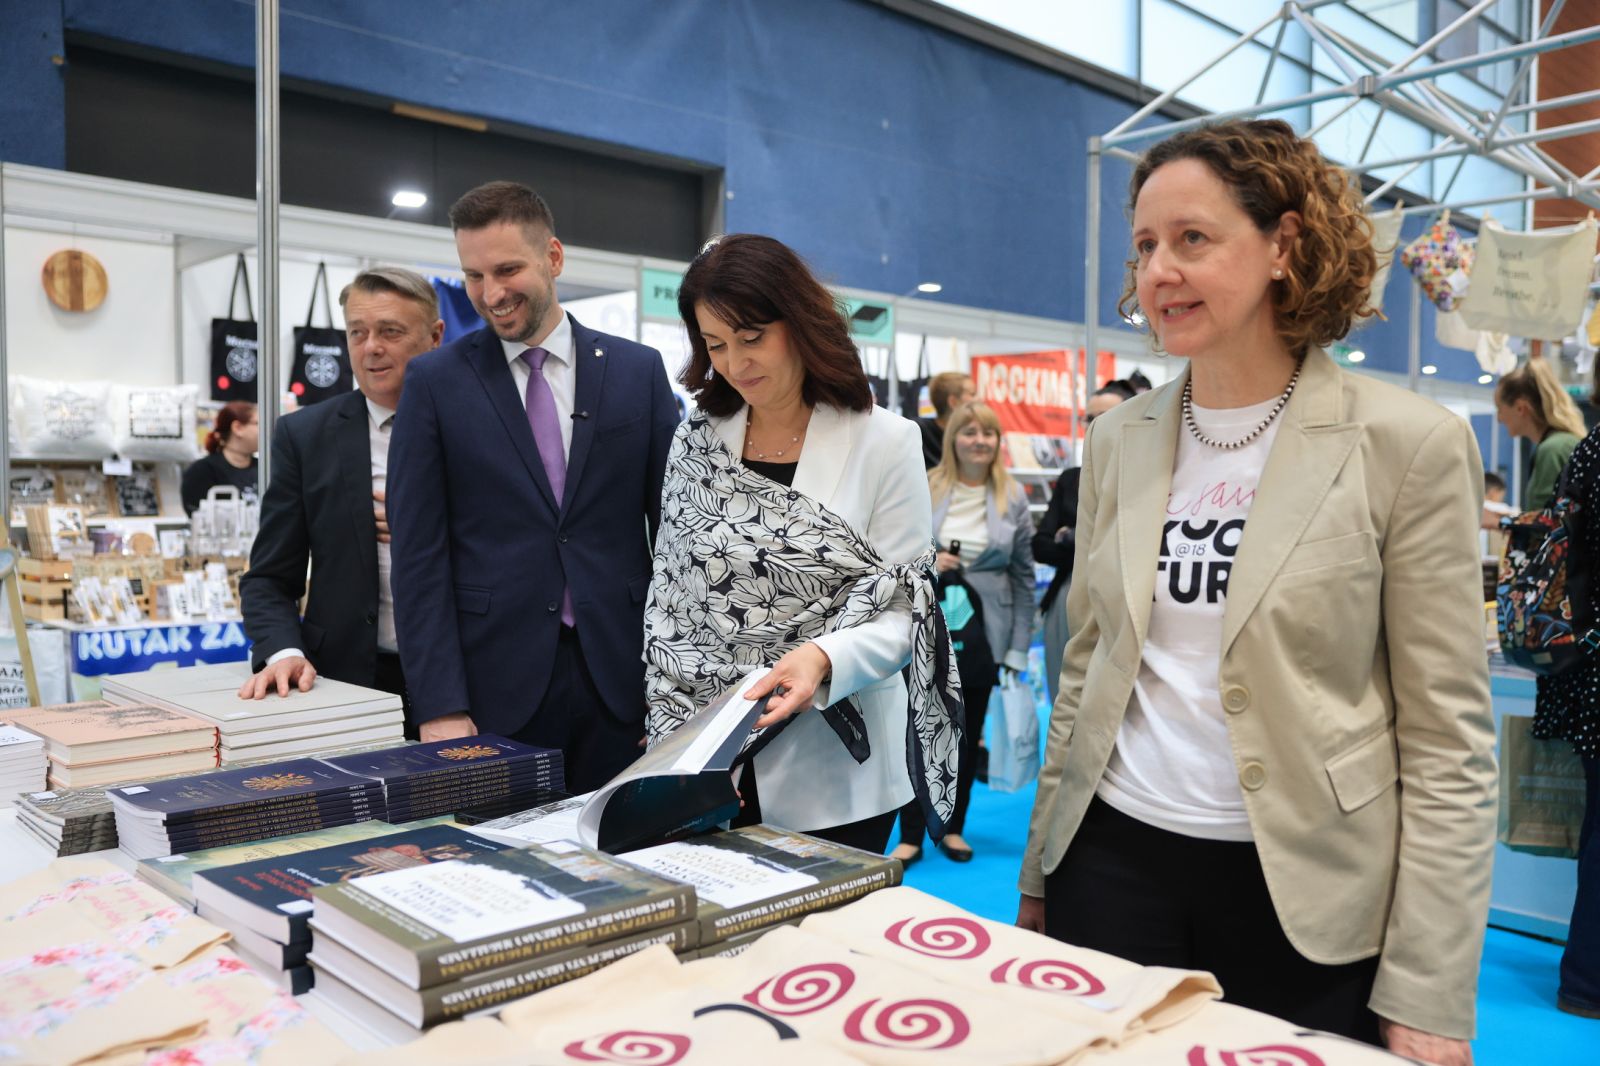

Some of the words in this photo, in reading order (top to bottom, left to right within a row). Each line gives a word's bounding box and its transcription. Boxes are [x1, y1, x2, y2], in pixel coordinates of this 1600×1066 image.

[1174, 542, 1207, 558] @18
[78, 626, 192, 661] KUTAK
[200, 621, 246, 650] ZA
